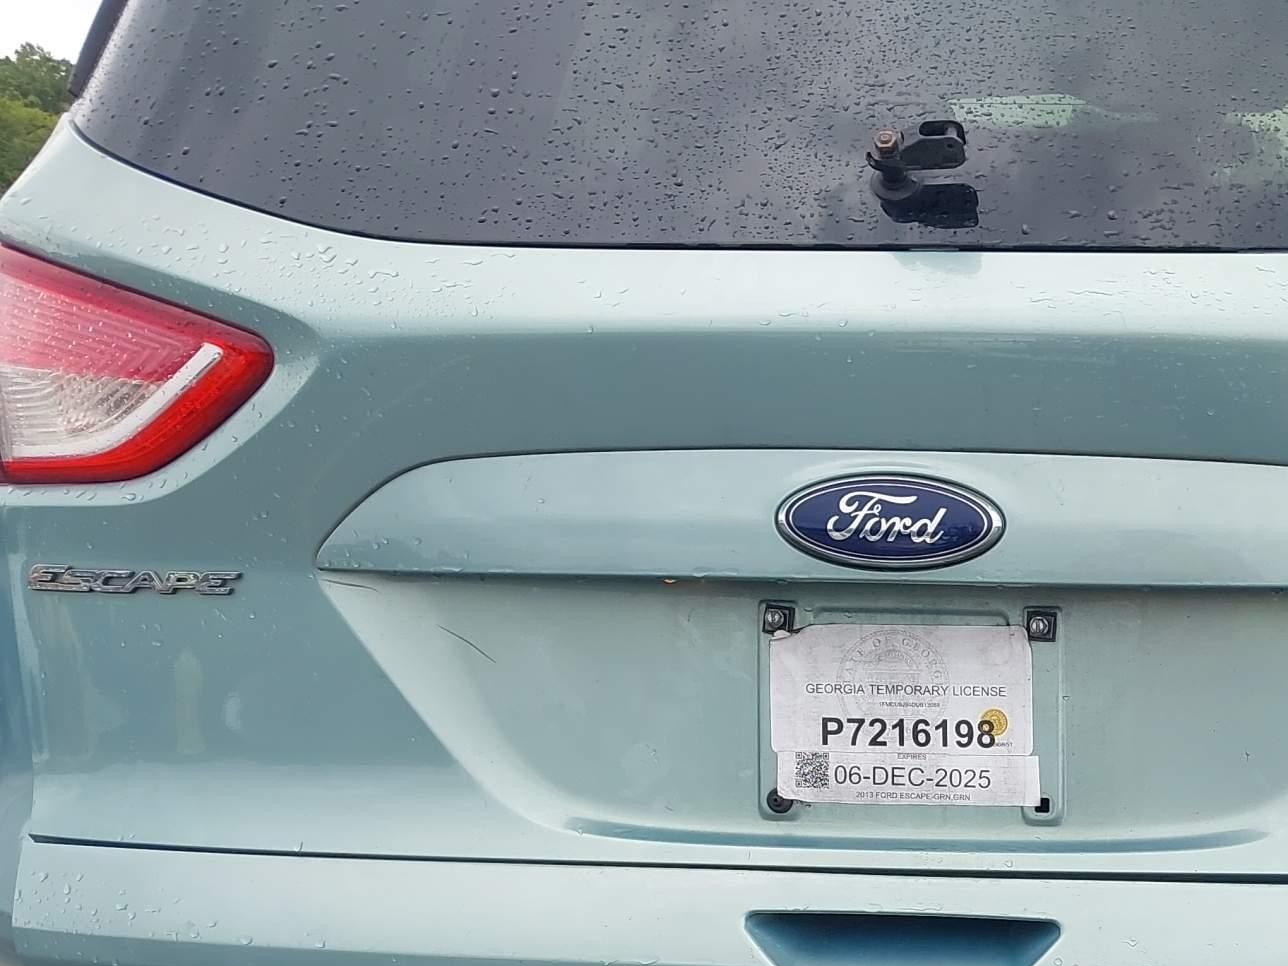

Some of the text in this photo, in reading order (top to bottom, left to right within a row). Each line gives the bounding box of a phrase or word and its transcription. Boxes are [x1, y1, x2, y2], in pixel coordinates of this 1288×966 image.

[827, 491, 947, 544] Ford
[28, 564, 242, 595] ESCAPE
[805, 683, 1007, 697] GEORGIA TEMPORARY LICENSE
[821, 716, 996, 749] P7216198
[897, 752, 927, 760] EXPIRES
[834, 764, 992, 789] 06-DEC-2025
[875, 791, 898, 799] FORD
